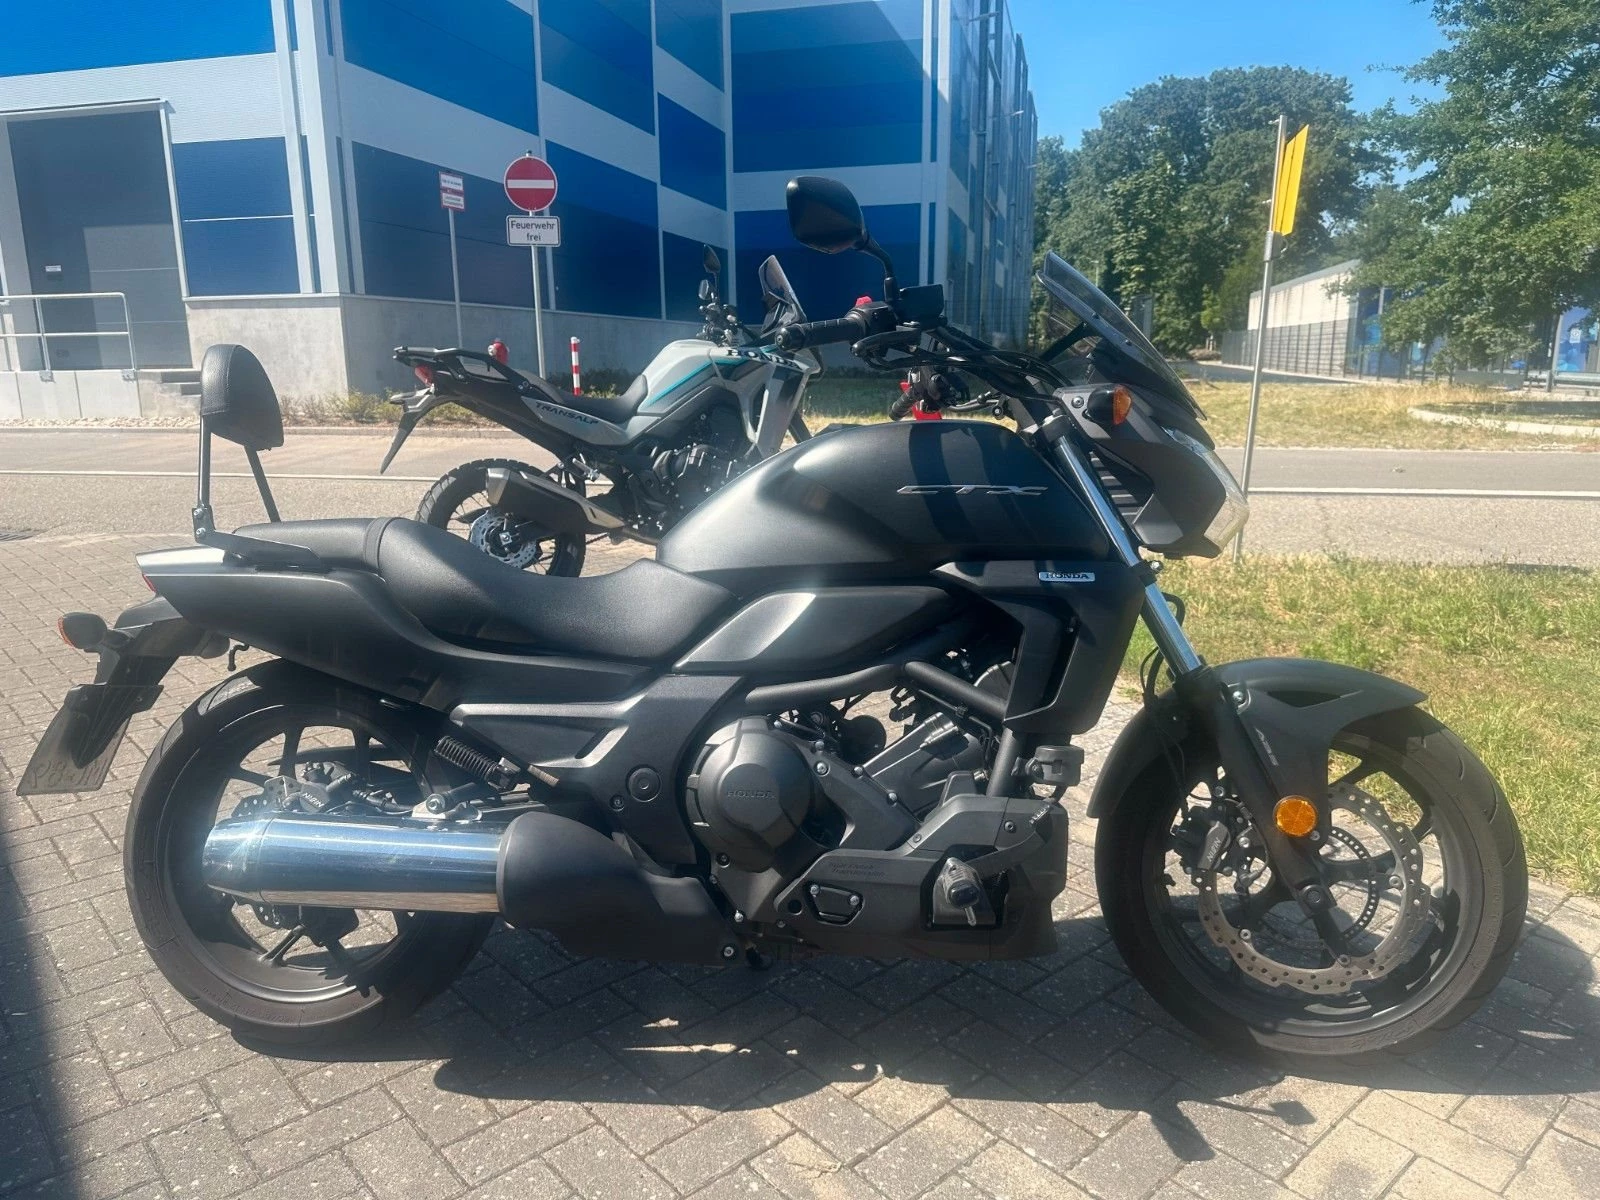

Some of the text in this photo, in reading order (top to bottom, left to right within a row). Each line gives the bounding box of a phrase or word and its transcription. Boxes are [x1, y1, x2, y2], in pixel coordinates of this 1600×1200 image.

[510, 220, 556, 230] Feuerwehr
[526, 233, 541, 241] frei
[727, 349, 804, 372] HONDA
[535, 401, 599, 425] TRANSALP
[896, 485, 1049, 496] CTX
[727, 789, 777, 799] HONDA
